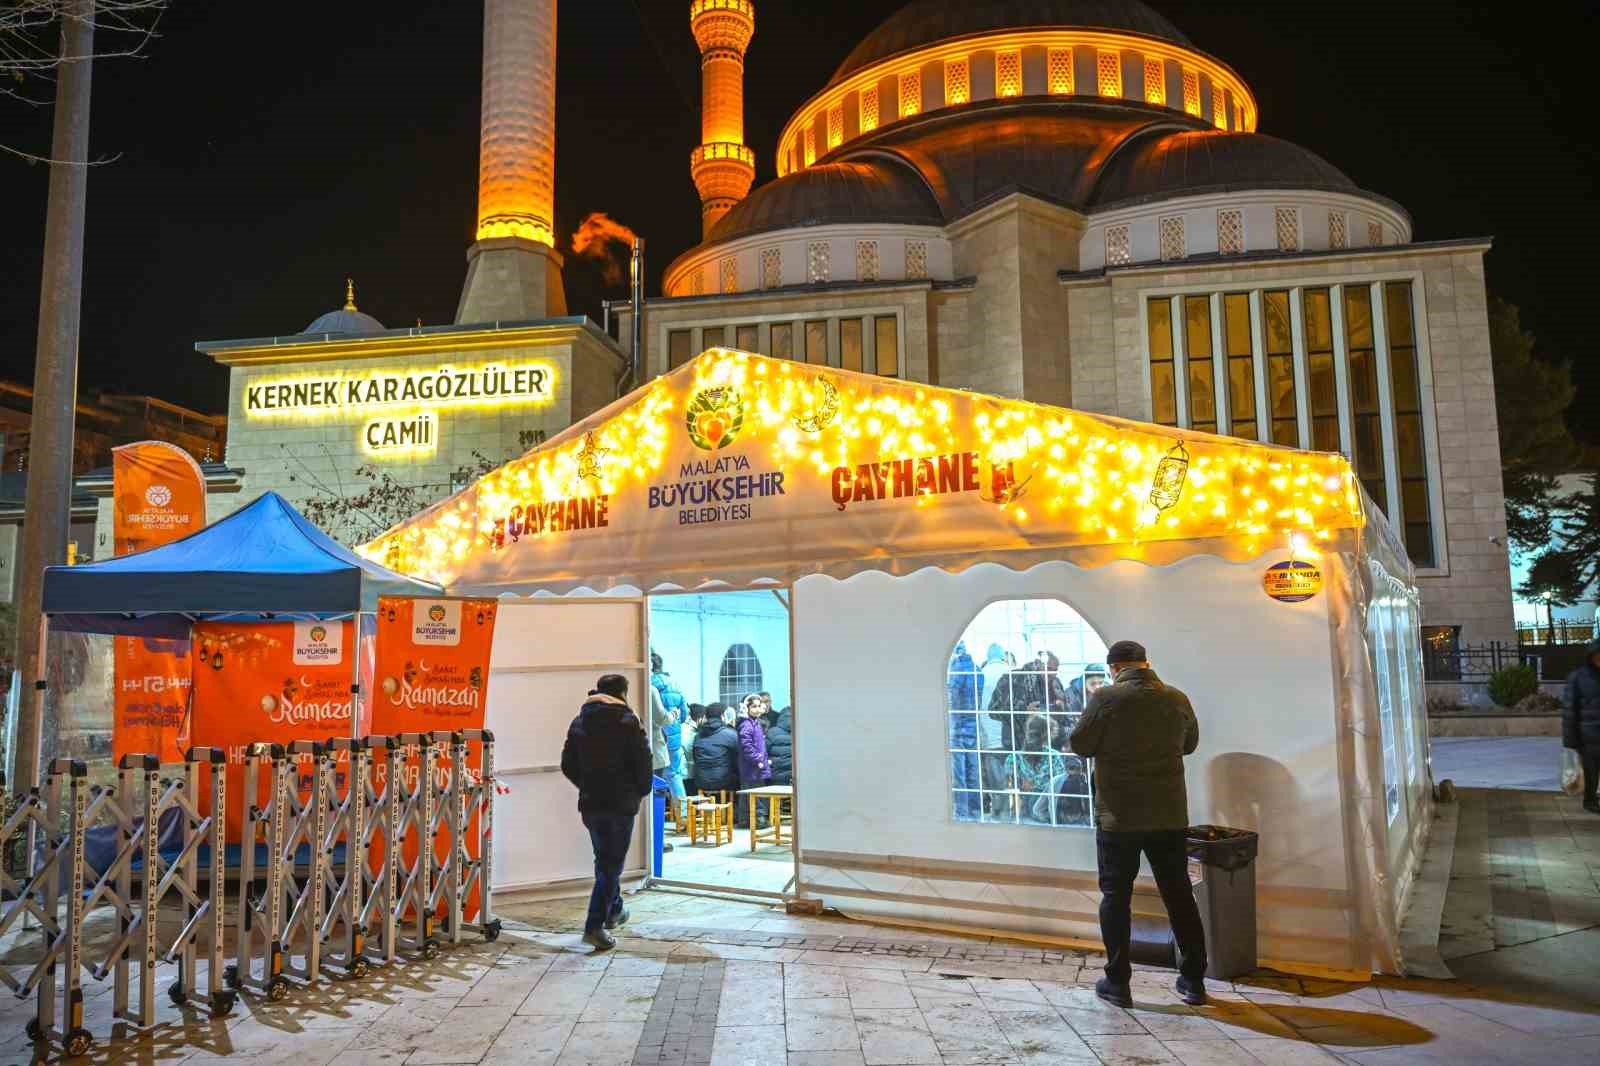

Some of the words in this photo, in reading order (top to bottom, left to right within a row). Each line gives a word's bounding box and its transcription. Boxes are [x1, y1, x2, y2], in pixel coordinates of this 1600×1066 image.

[248, 380, 338, 410] KERNEK
[347, 366, 544, 404] KARAGÖZLÜLER
[366, 415, 431, 447] CAMİİ
[680, 455, 751, 479] MALATYA
[831, 451, 981, 511] ÇAYHANE
[648, 471, 785, 509] BÜYÜKŞEHİR
[508, 494, 609, 542] ÇAYHANE
[679, 503, 752, 526] BELEDİYESİ
